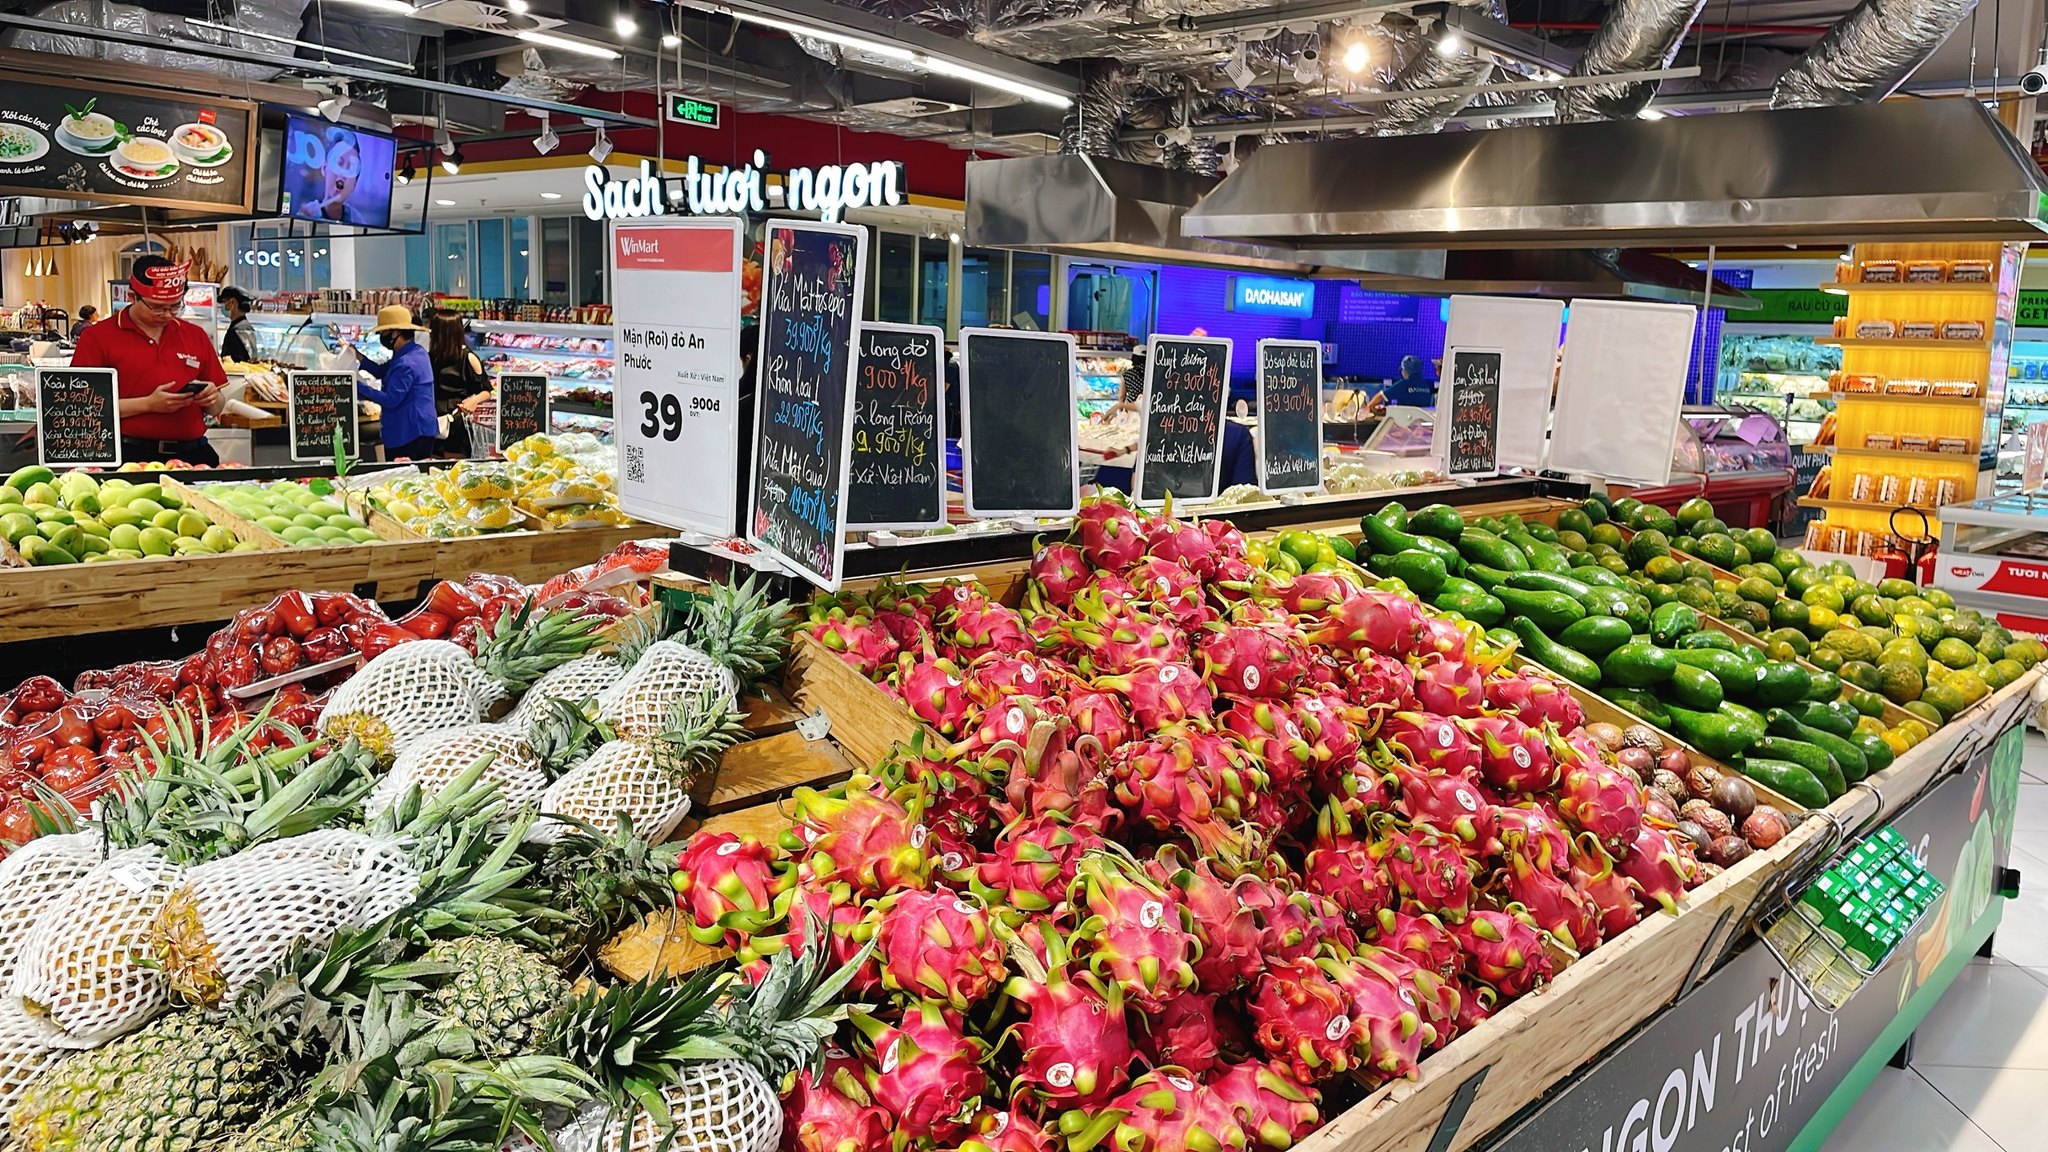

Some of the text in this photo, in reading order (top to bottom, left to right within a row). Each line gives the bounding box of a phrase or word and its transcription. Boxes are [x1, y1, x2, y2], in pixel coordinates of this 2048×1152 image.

[621, 237, 659, 256] WinMart
[623, 328, 642, 347] Mận
[645, 331, 668, 350] (Roi)
[689, 333, 705, 350] An
[624, 353, 652, 370] Phước
[640, 390, 683, 442] 39
[1760, 1063, 1788, 1139] of
[1788, 1012, 1840, 1106] fresh
